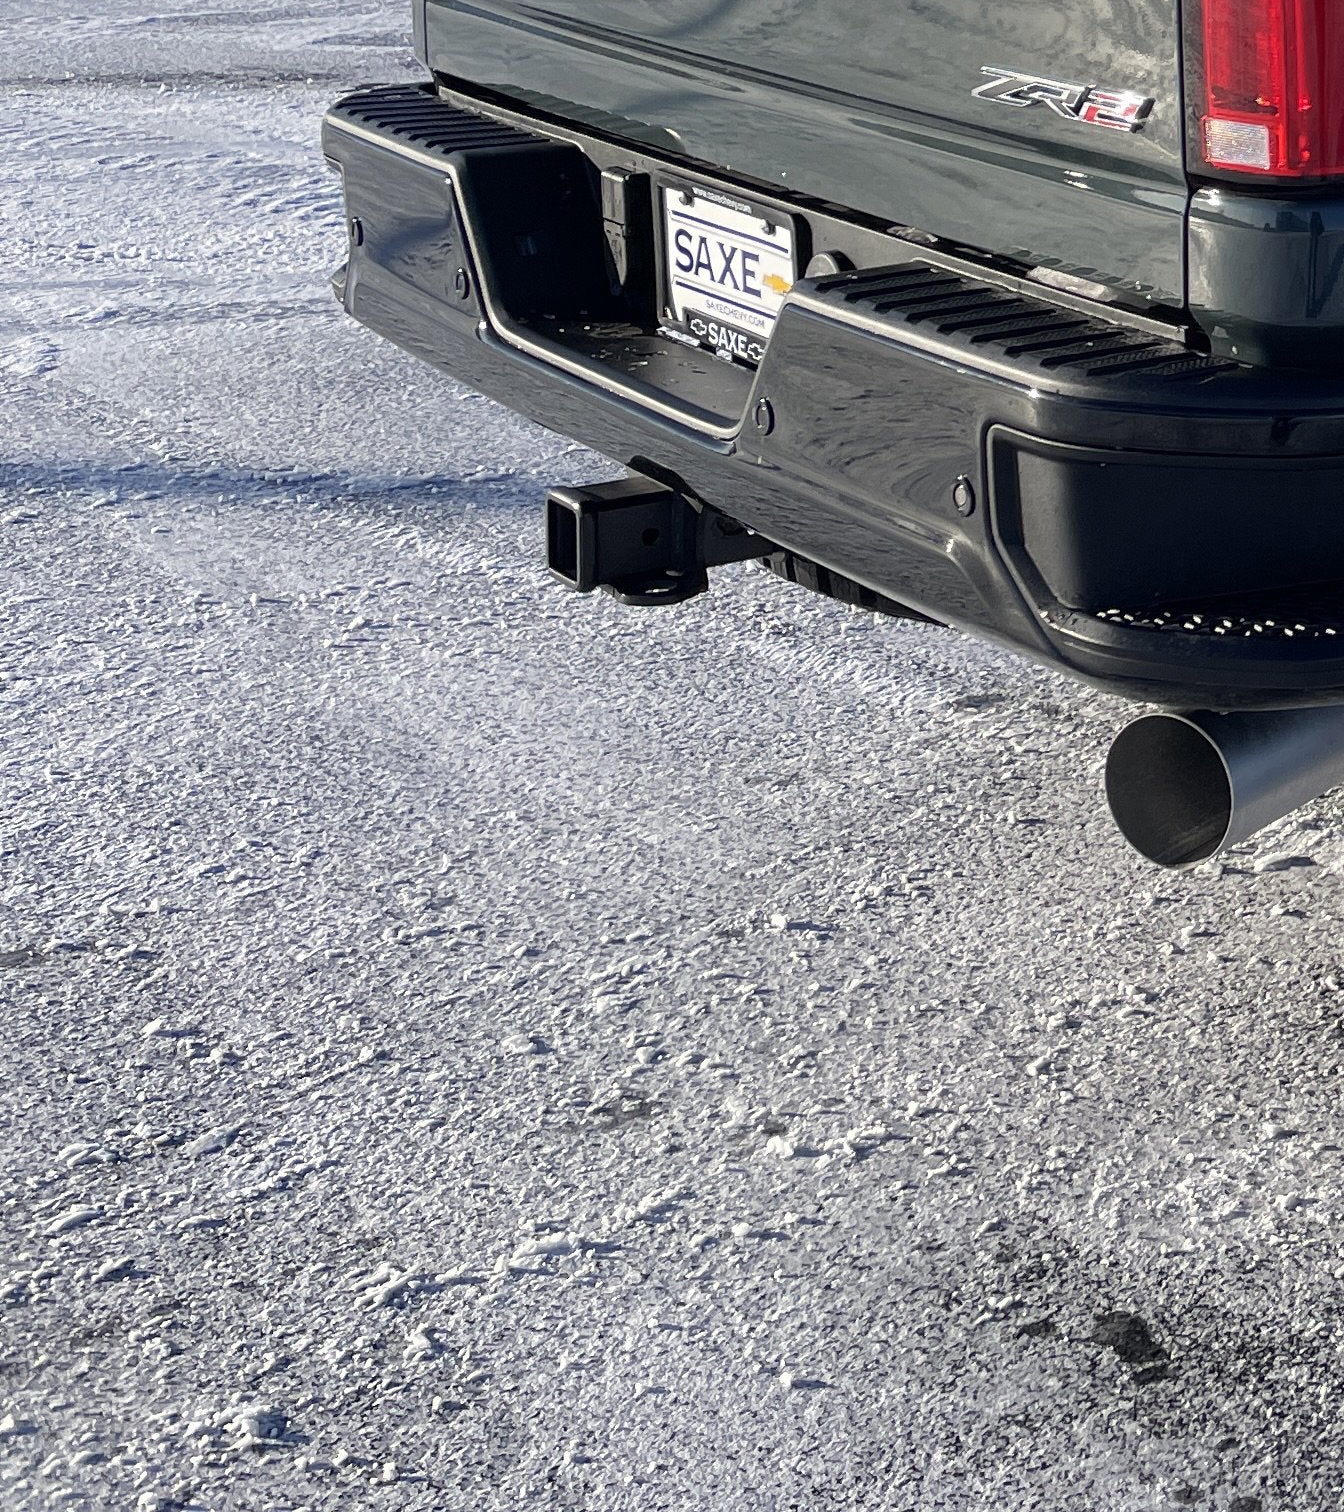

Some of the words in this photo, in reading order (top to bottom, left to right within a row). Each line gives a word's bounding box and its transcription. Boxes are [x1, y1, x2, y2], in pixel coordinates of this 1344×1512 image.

[971, 65, 1156, 133] ZR2
[675, 229, 762, 298] SAXE
[707, 322, 748, 359] SAXE
